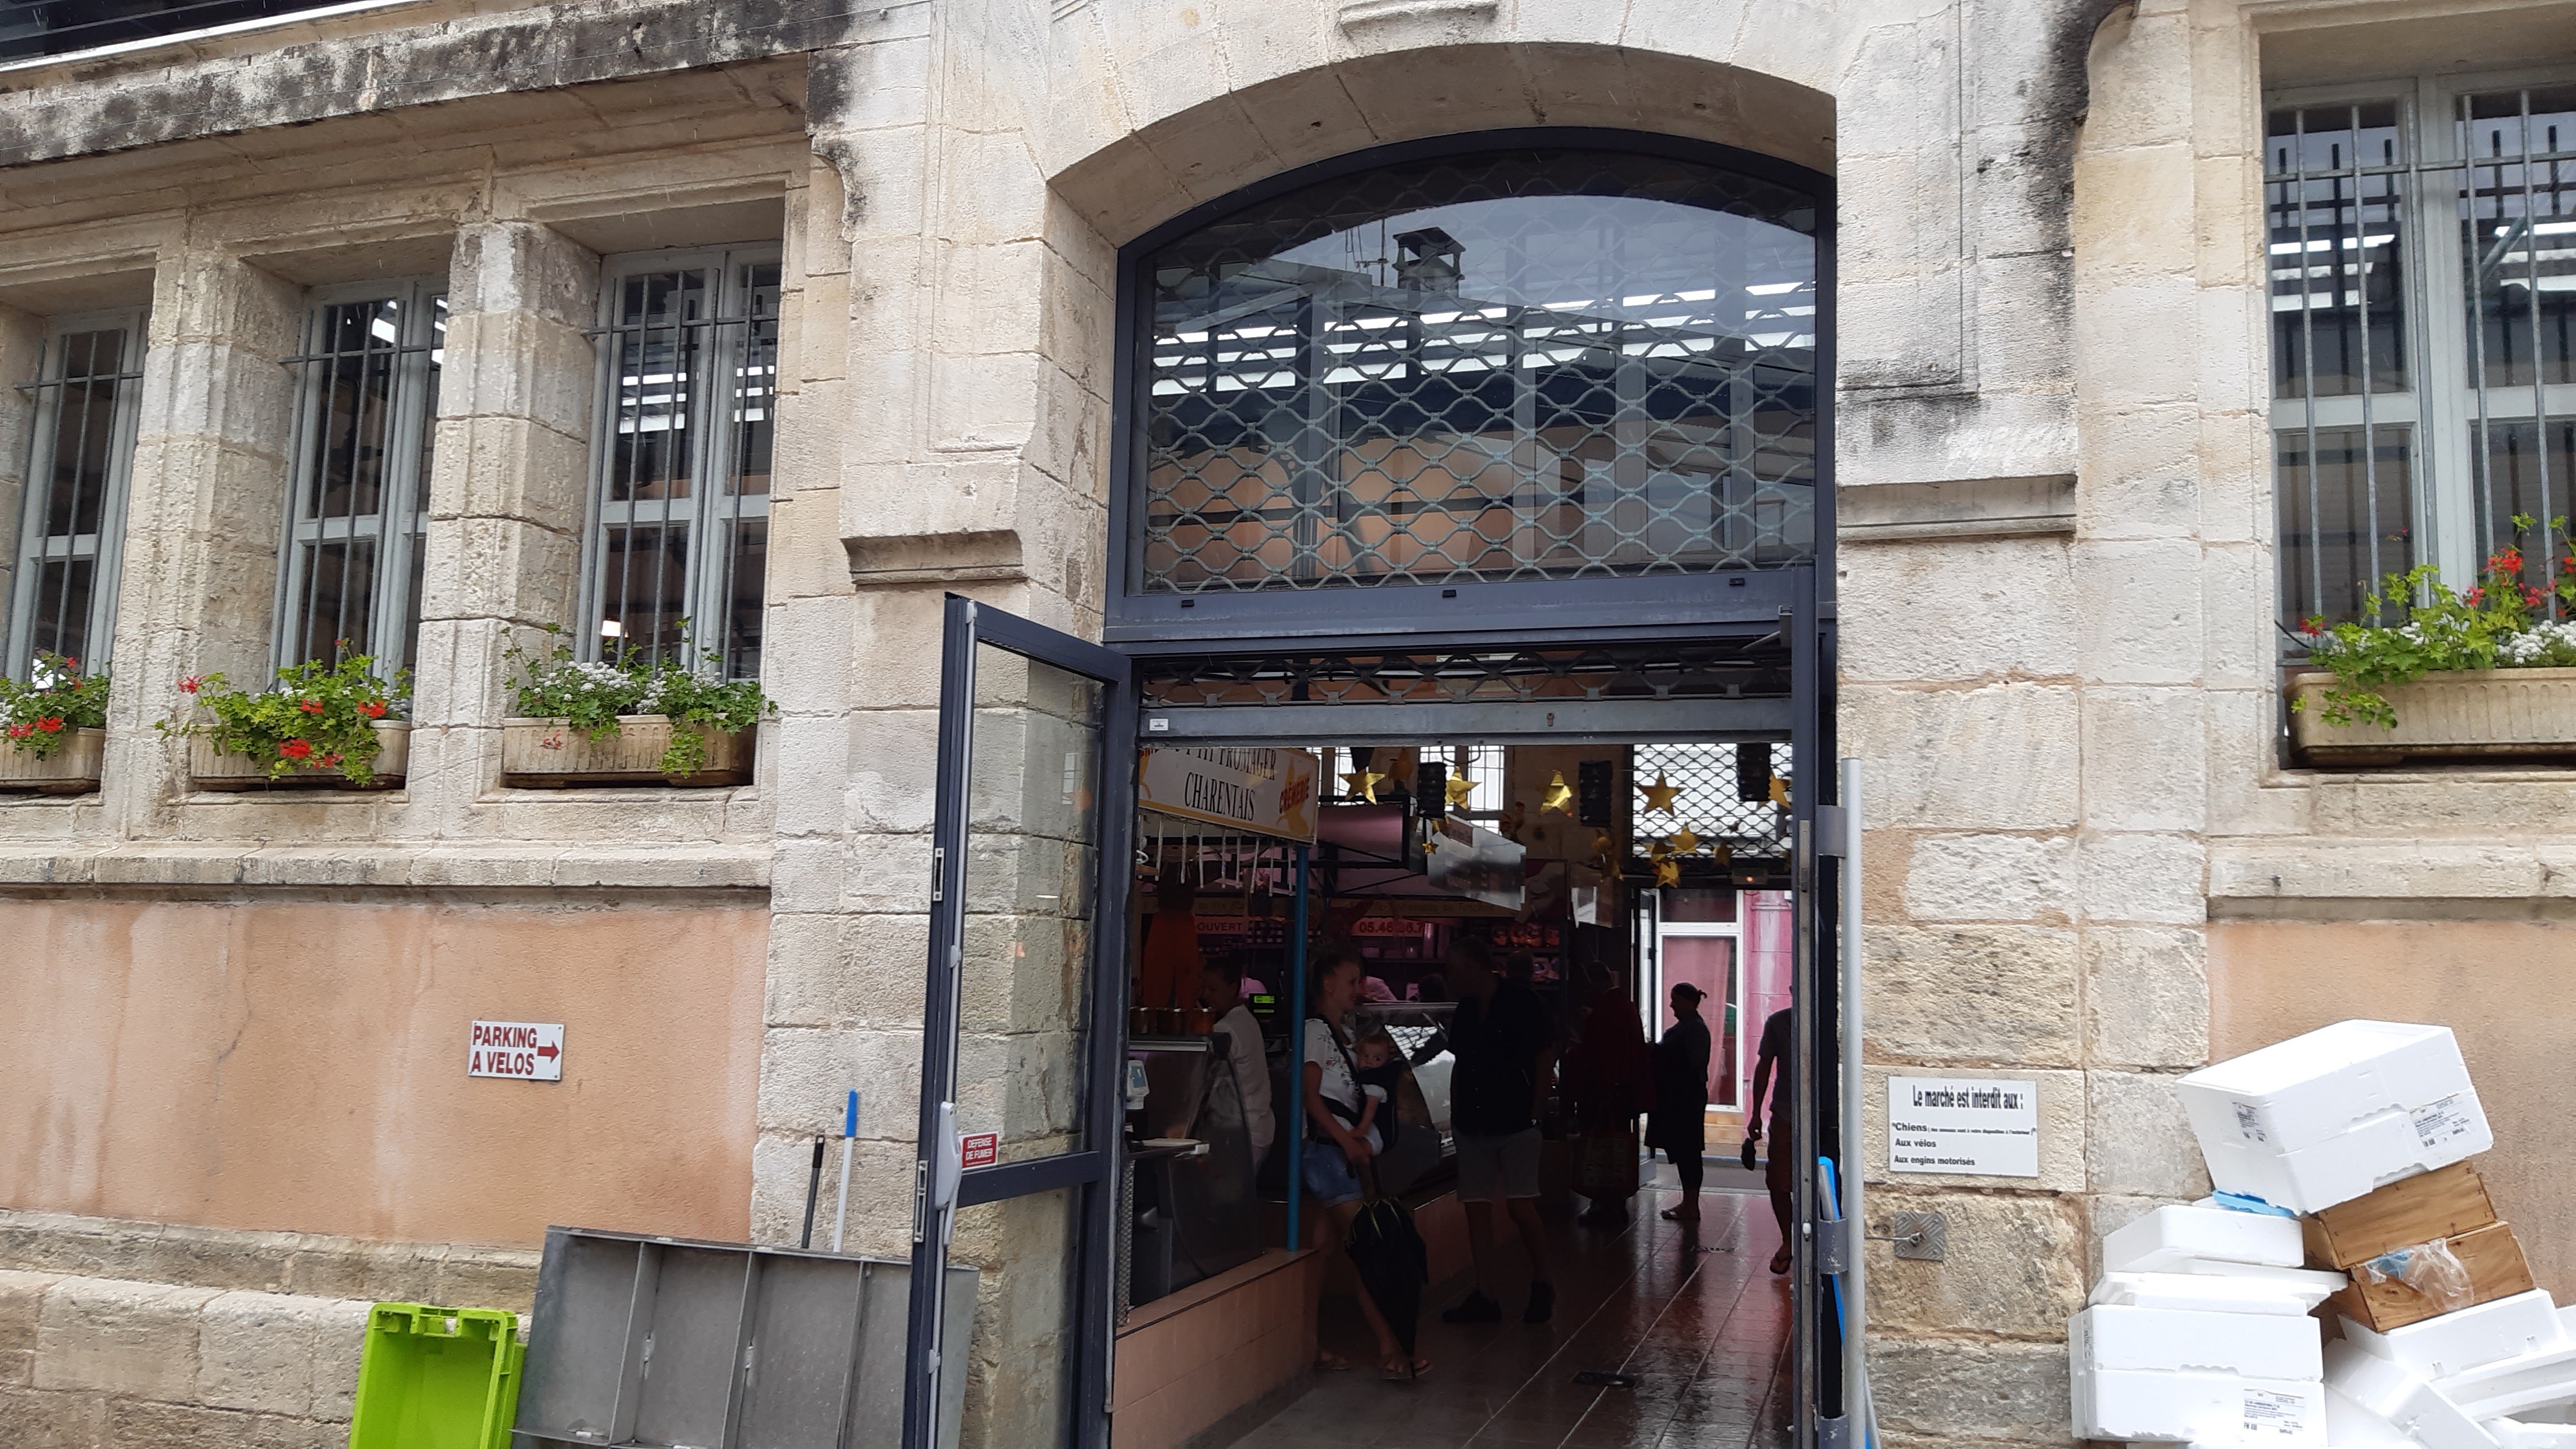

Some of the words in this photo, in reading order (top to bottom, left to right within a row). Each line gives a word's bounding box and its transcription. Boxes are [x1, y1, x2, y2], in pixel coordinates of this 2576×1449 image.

[1185, 771, 1255, 821] CHARENTAIS
[1198, 922, 1242, 931] OUVERT
[472, 1025, 537, 1049] PARKING
[471, 1050, 481, 1072] A
[487, 1052, 535, 1076] VELOS
[1912, 1085, 1922, 1107] Le
[1925, 1085, 1954, 1108] marché
[1957, 1088, 1969, 1109] est
[1972, 1086, 2001, 1109] interdit
[2004, 1091, 2018, 1110] aux
[1895, 1138, 1912, 1147] Aux
[1914, 1138, 1936, 1148] vélos
[965, 1150, 974, 1161] DE
[1894, 1155, 1908, 1163] Aux
[1911, 1156, 1935, 1166] engins
[1938, 1157, 1975, 1166] motorisés
